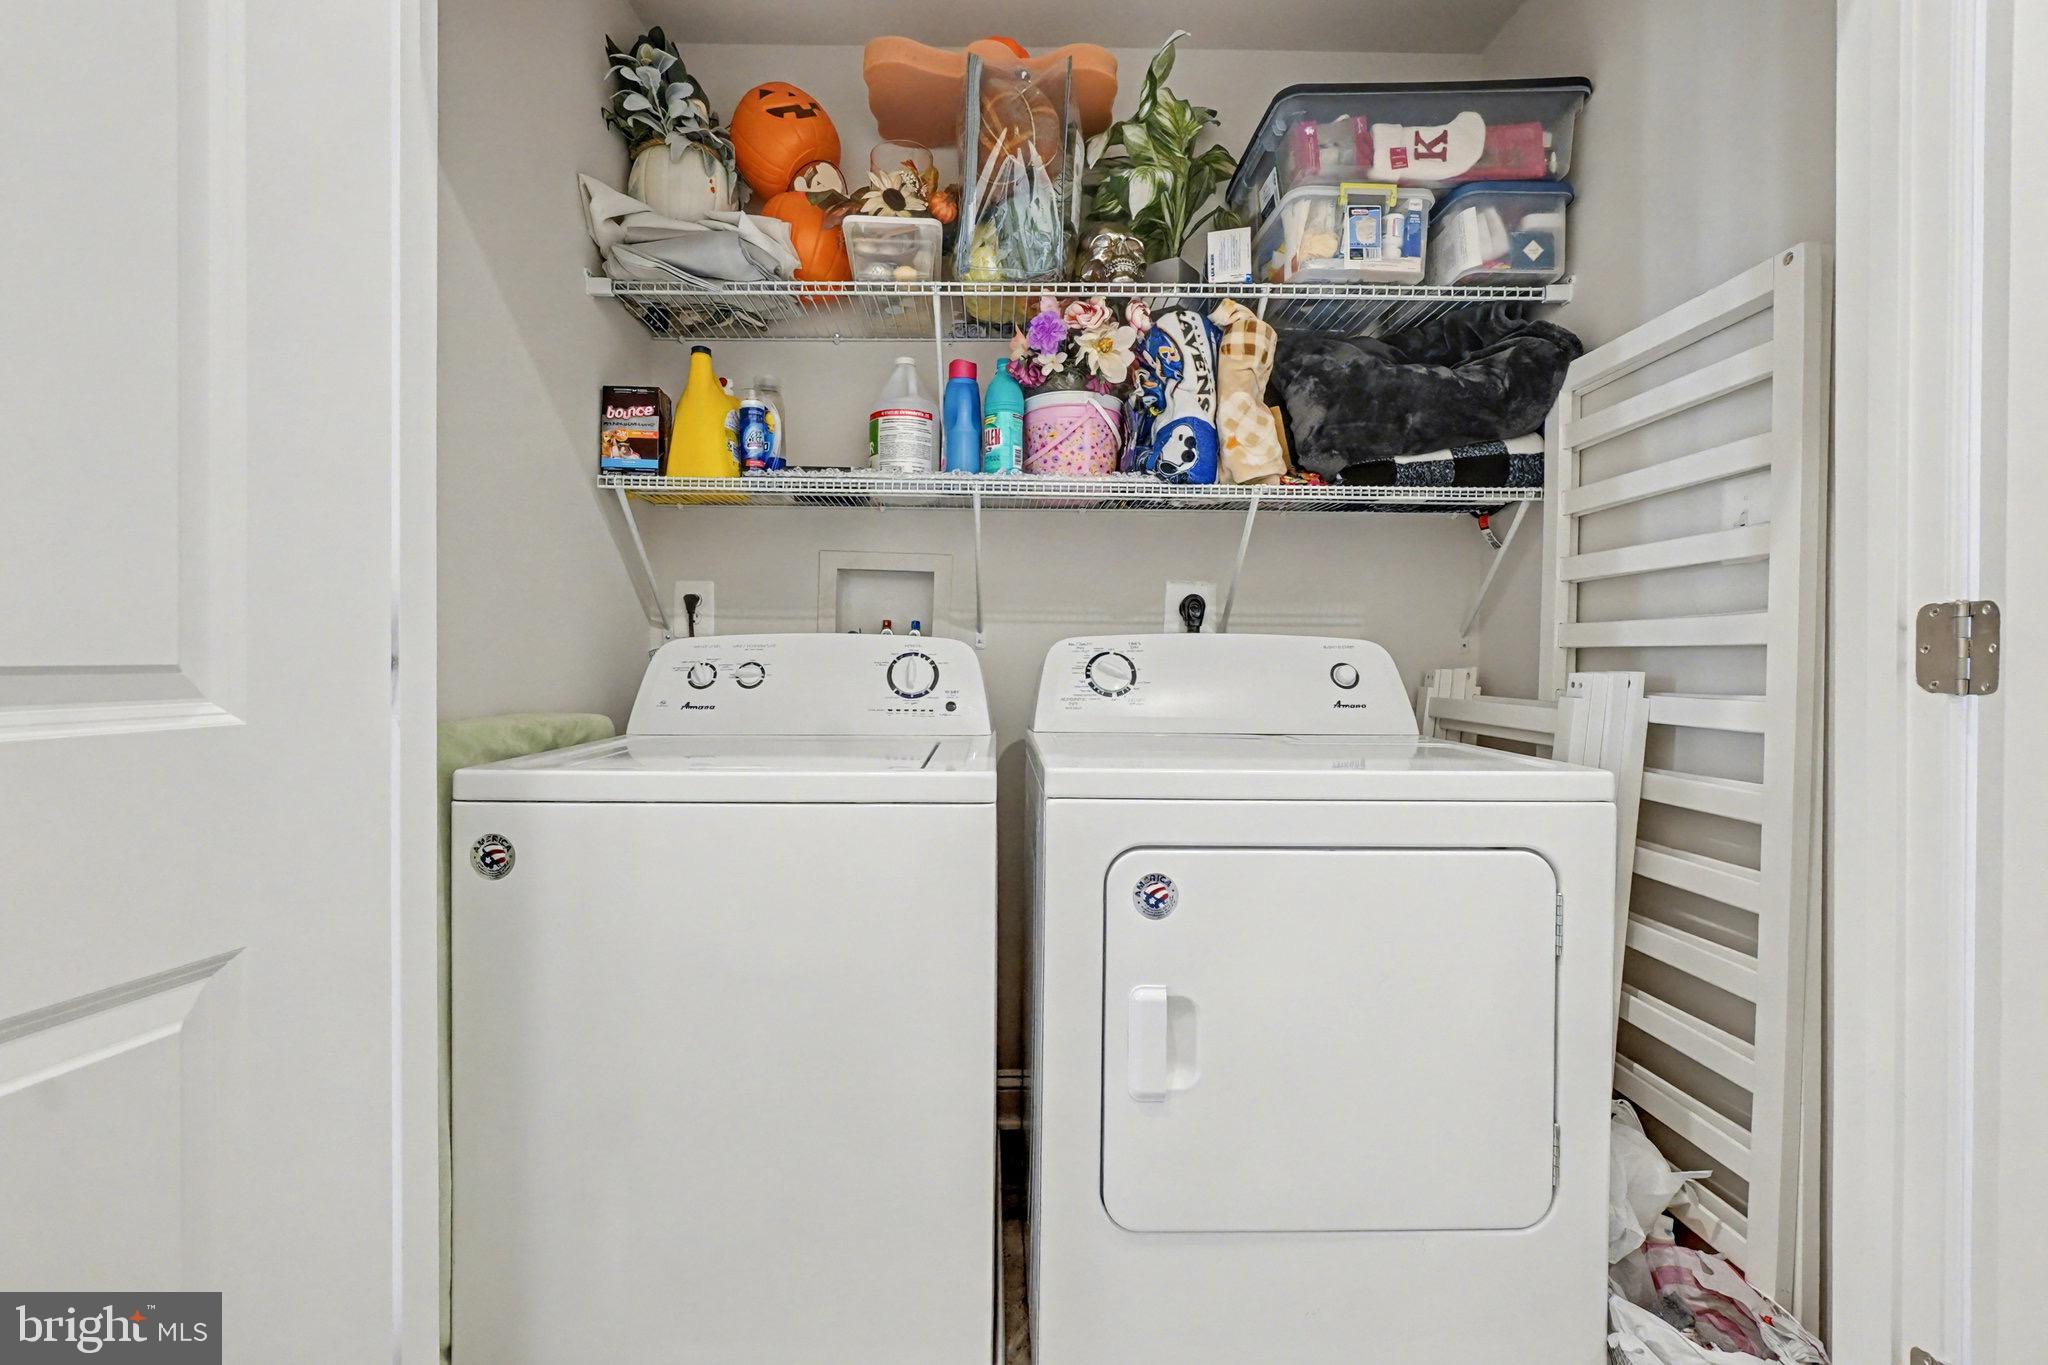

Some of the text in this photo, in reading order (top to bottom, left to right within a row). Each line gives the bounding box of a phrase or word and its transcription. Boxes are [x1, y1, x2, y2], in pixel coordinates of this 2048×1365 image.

[1414, 129, 1448, 162] K
[606, 405, 654, 420] bounce
[680, 701, 717, 710] Amana
